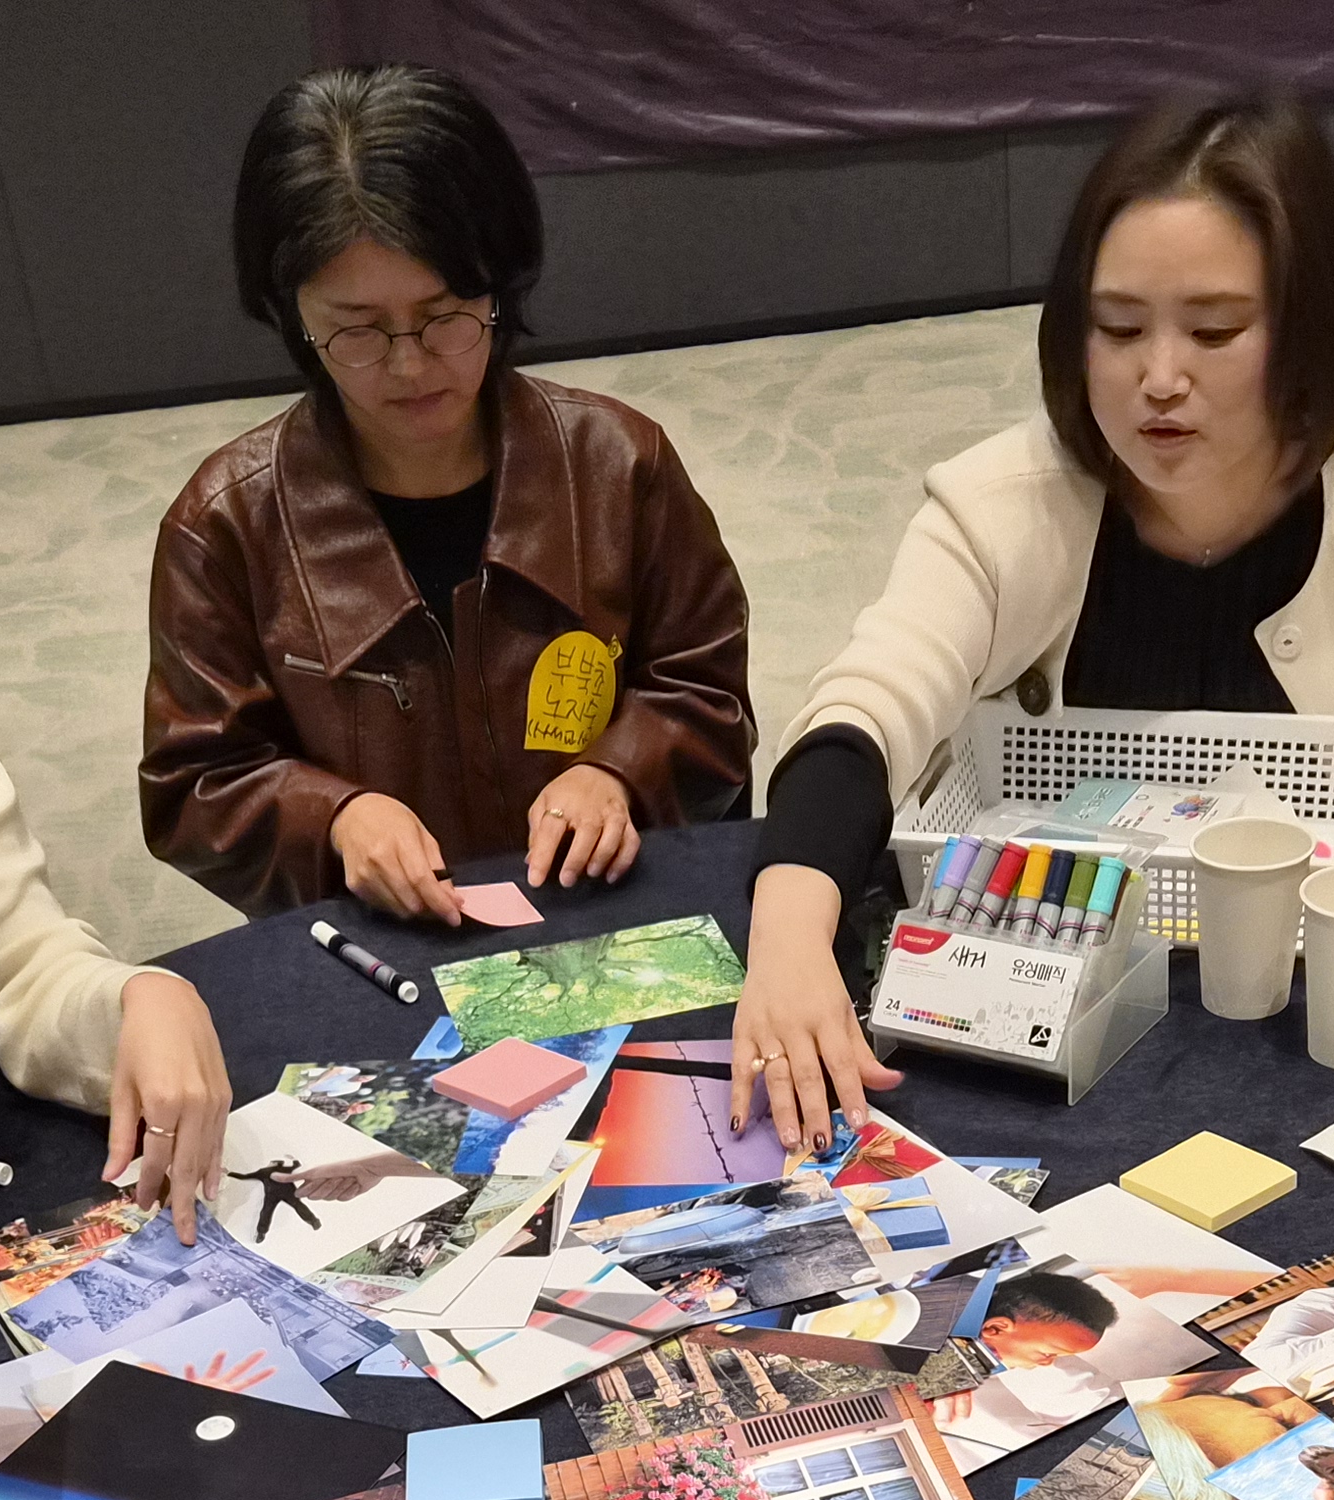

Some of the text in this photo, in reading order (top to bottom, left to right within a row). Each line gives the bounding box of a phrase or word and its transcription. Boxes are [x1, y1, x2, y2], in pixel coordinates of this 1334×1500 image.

[948, 944, 987, 969] 새거
[1012, 958, 1067, 984] 유성매직
[885, 998, 901, 1011] 24
